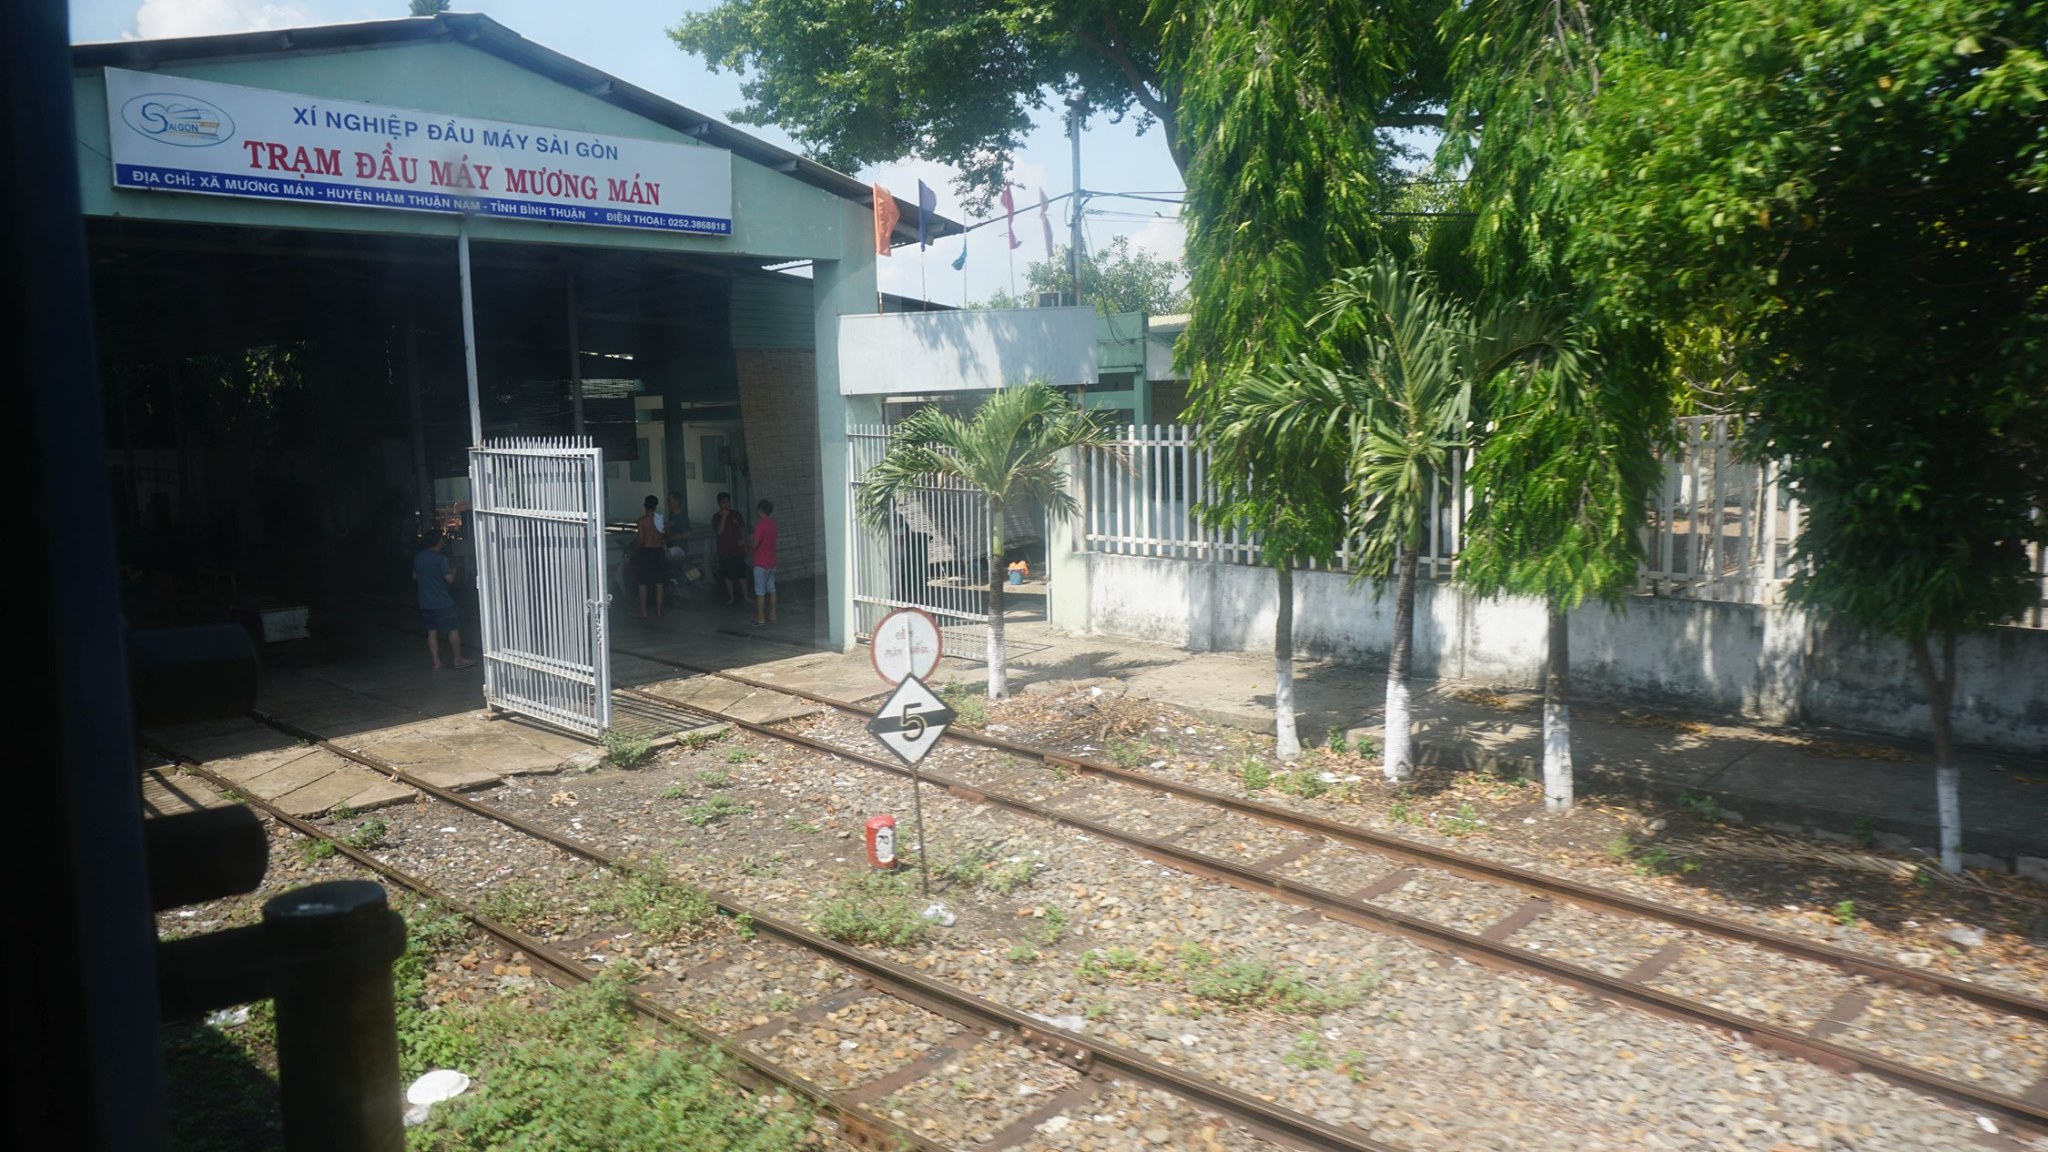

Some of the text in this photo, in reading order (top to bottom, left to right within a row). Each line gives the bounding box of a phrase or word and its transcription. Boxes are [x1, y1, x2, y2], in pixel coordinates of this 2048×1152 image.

[293, 105, 618, 160] XÍ NGHIỆP ĐẦU MÁY SÀI GÒN
[132, 170, 160, 184] ĐỊA
[164, 172, 196, 187] CHỈ:
[200, 175, 221, 189] XÃ
[225, 179, 279, 194] MƯƠNG
[283, 183, 314, 197] MÁN
[326, 187, 372, 202] HUYỆN
[376, 190, 405, 204] HÀM
[408, 194, 450, 209] THUẬN
[453, 200, 481, 211] NAM
[490, 200, 517, 213] TỈNH
[520, 204, 547, 216] BÌNH
[549, 207, 586, 221] THUẬN
[606, 212, 631, 225] ĐIỆN
[633, 215, 666, 227] THOẠI:
[243, 140, 660, 206] TRẠM ĐẦU MÁY MƯƠNG MÁN
[902, 702, 926, 742] 5
